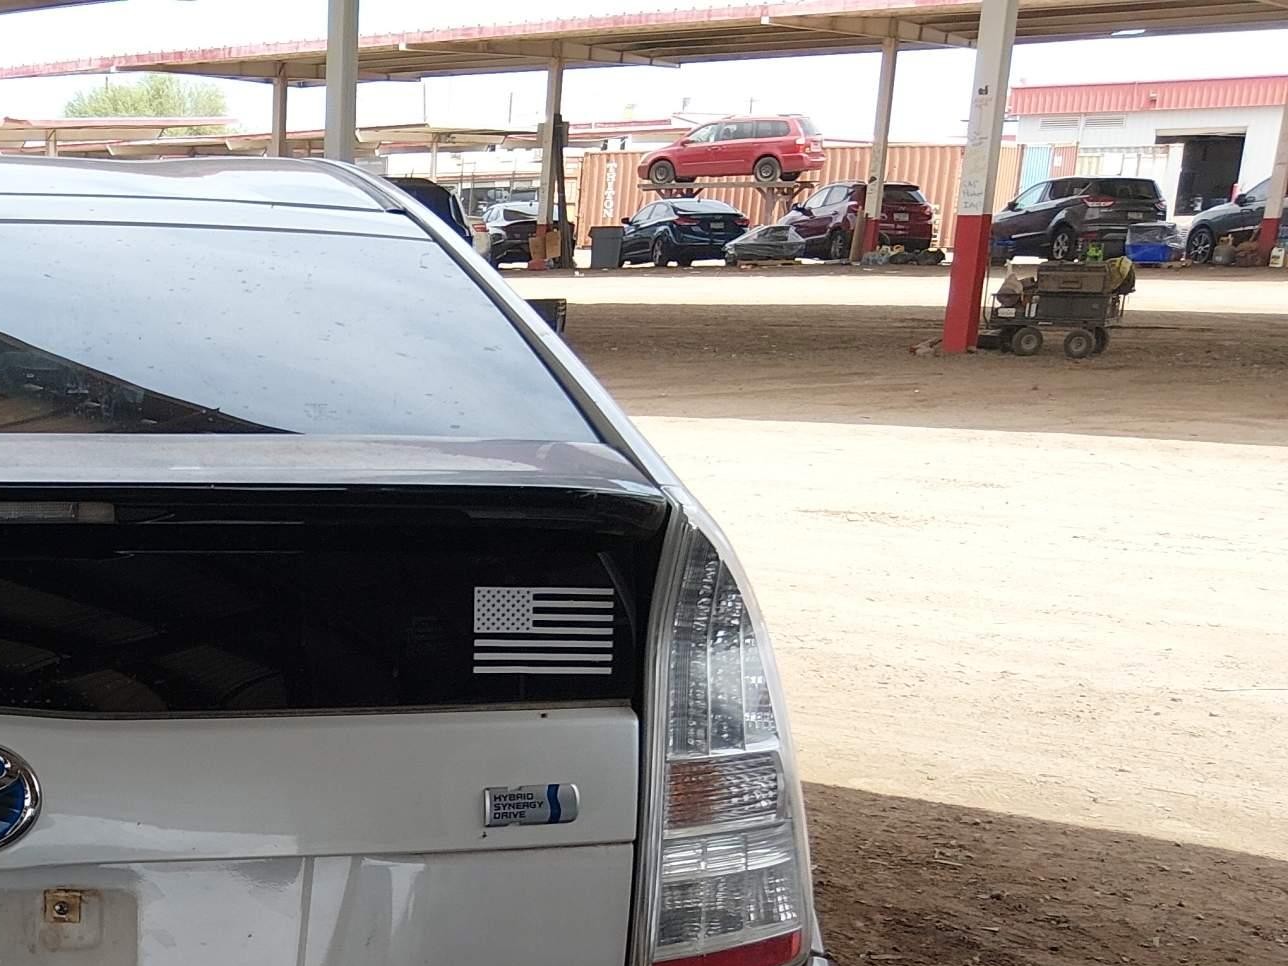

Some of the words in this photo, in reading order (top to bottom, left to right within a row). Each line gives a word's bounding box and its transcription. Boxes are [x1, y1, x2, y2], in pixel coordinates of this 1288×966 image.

[602, 162, 617, 218] TRITON
[493, 792, 534, 803] HYBRID
[493, 801, 544, 812] SYNERGY
[493, 811, 527, 820] DRIVE
